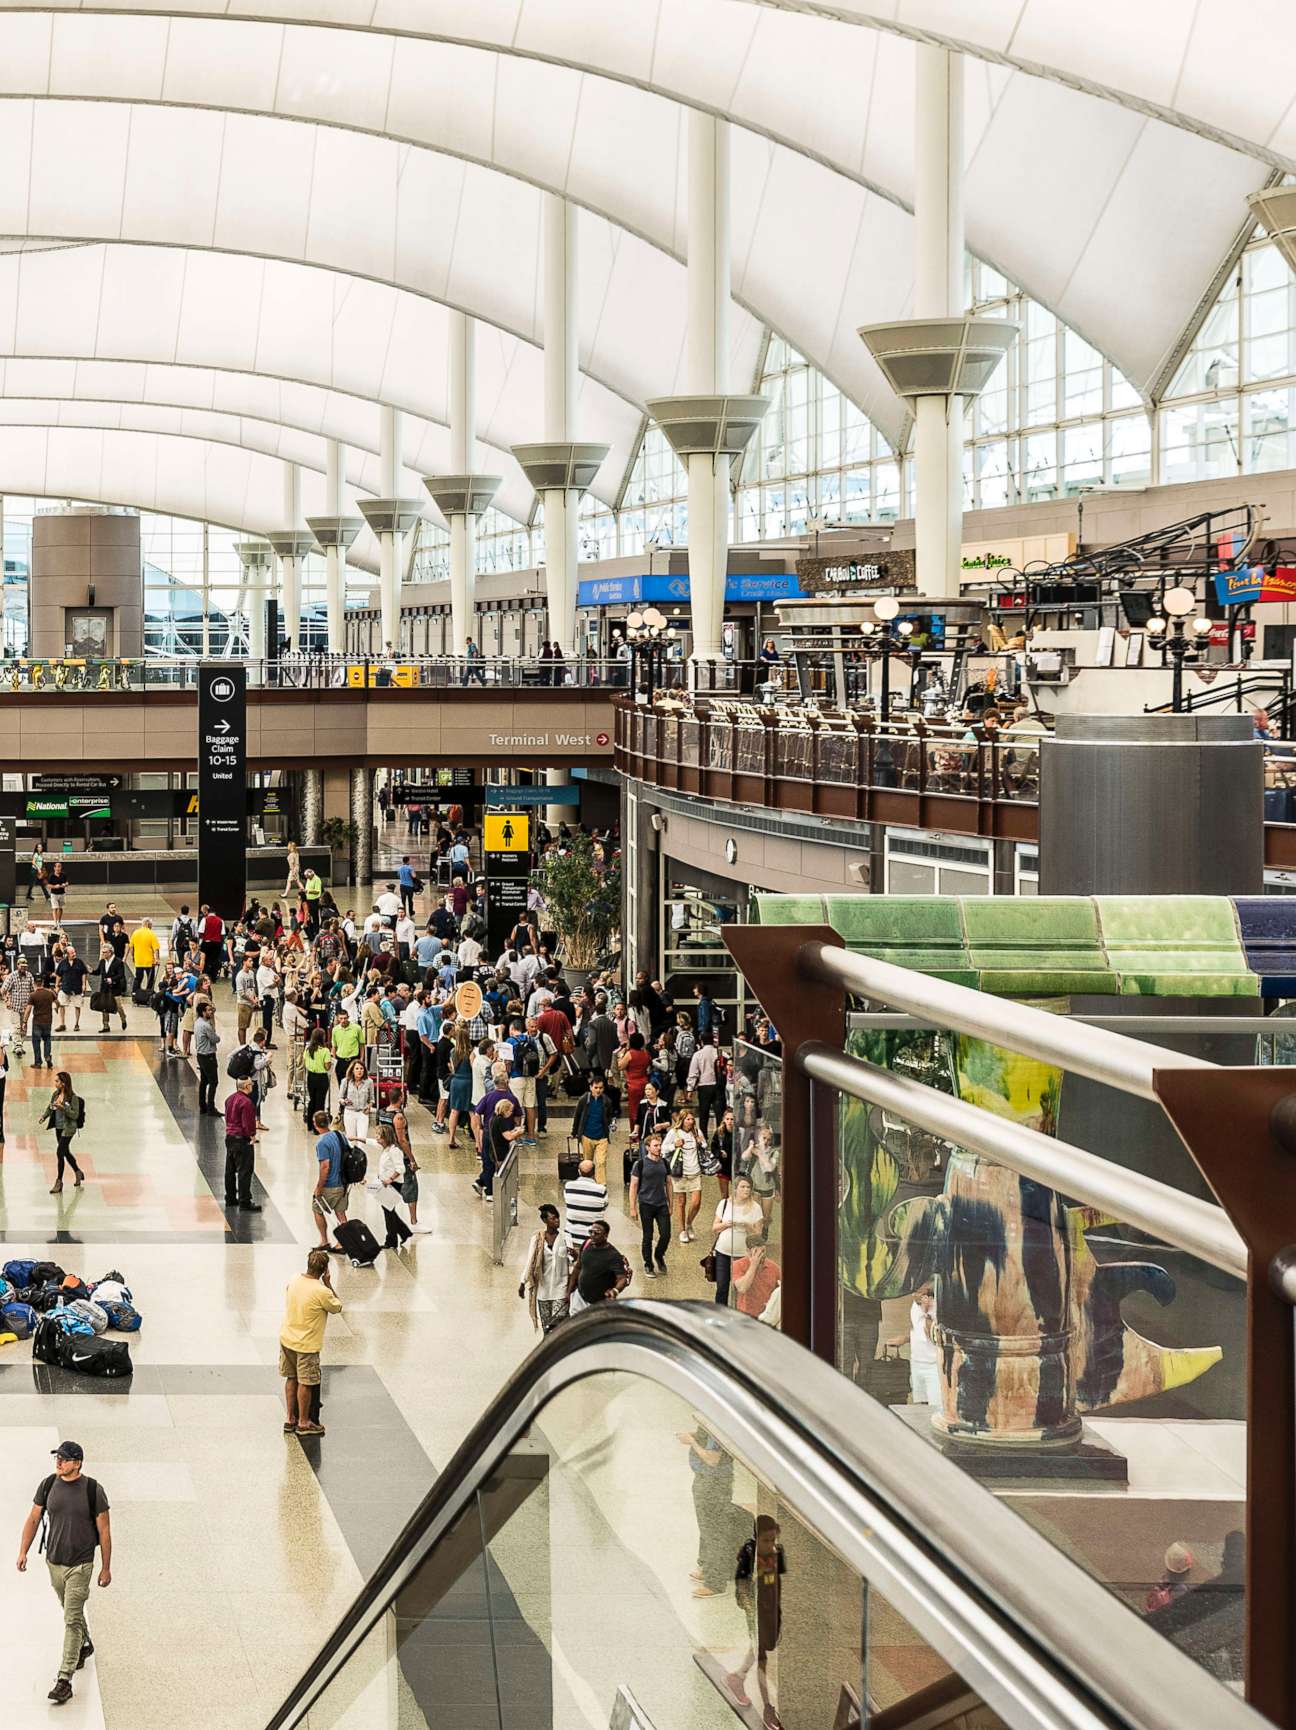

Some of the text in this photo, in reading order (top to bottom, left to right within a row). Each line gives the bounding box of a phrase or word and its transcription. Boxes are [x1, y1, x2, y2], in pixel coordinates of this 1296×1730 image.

[856, 564, 880, 581] COFFEE
[205, 735, 240, 744] Baggage
[489, 734, 592, 746] Terminal West
[211, 744, 234, 753] Claim
[208, 755, 237, 766] 10-15
[212, 772, 233, 780] United
[36, 802, 69, 810] National
